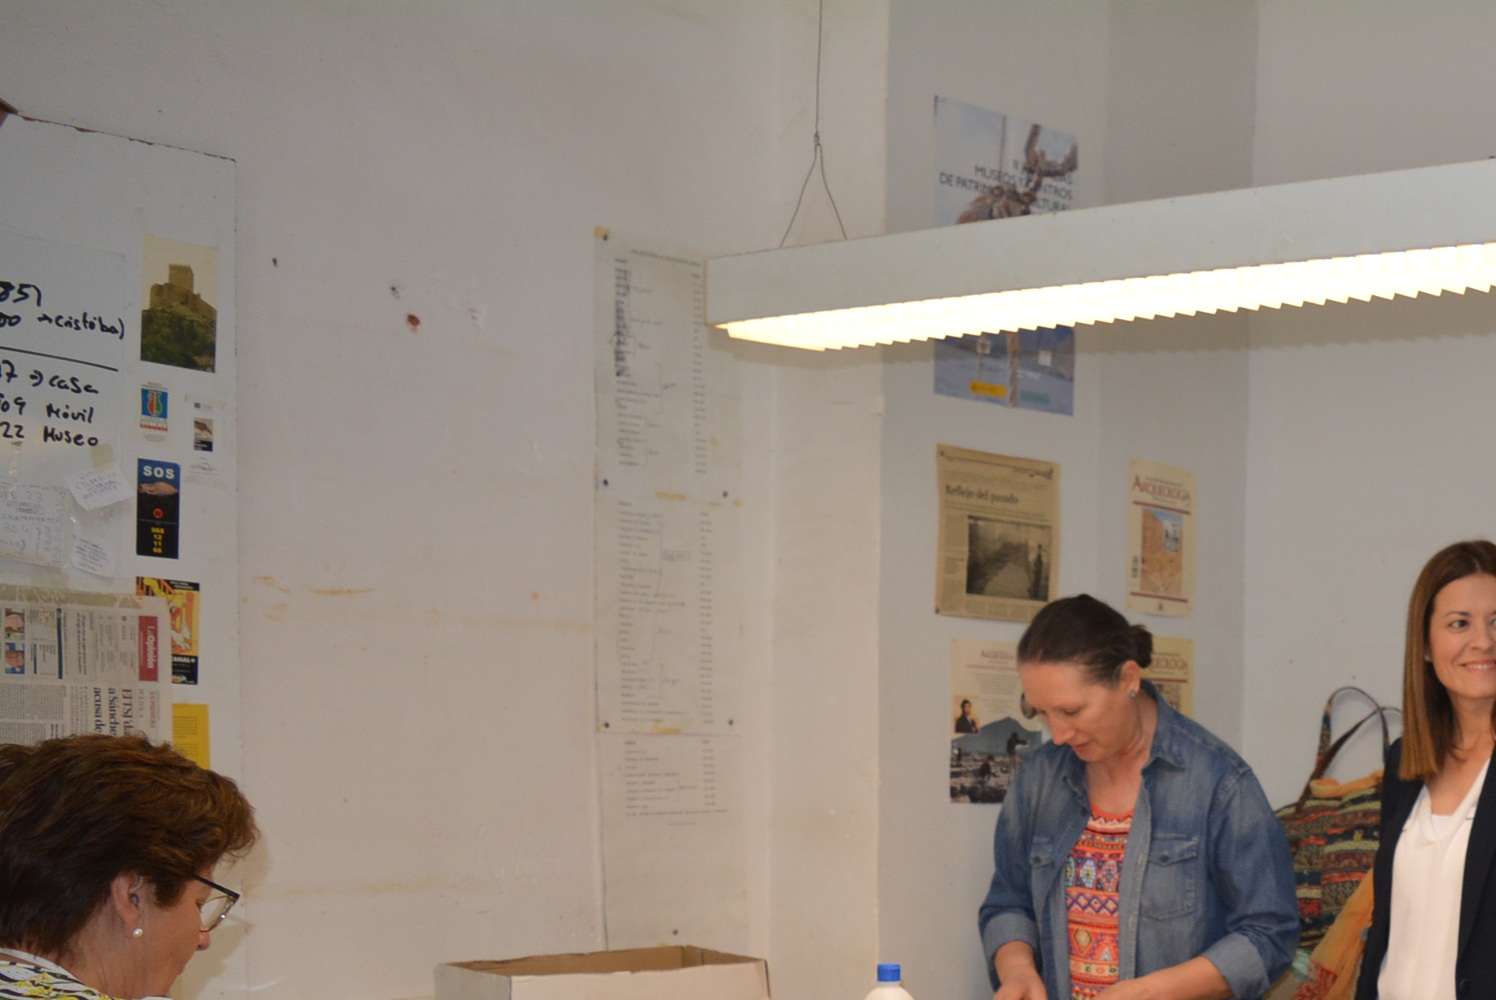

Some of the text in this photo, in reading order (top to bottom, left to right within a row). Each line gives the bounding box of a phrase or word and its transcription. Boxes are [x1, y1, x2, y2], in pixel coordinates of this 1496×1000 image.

[143, 465, 175, 480] SOS
[975, 490, 988, 500] del
[171, 656, 196, 664] ANAL+
[108, 695, 119, 737] Sánche
